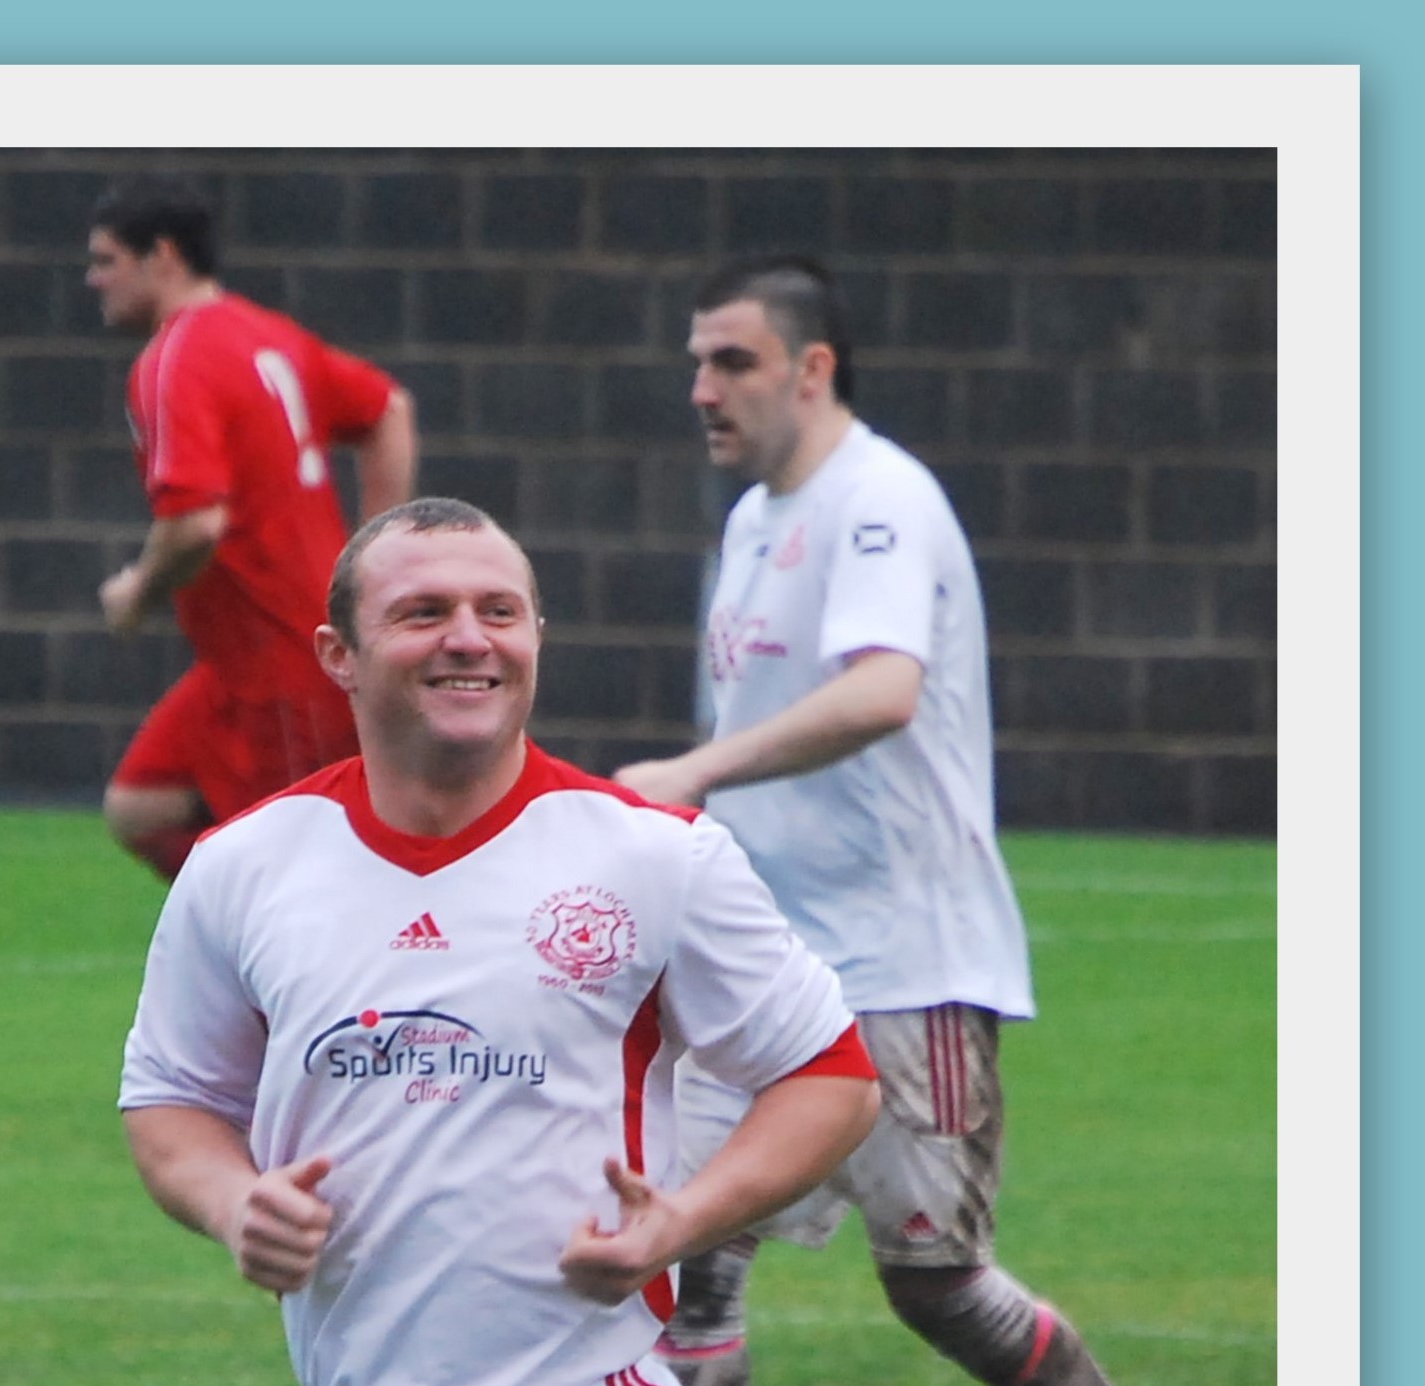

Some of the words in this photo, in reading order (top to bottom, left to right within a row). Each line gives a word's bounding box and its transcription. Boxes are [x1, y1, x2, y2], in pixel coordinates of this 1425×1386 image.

[595, 887, 631, 919] LOCH
[389, 937, 449, 951] adidas
[402, 1023, 471, 1046] Stadium
[328, 1046, 436, 1083] Sports
[450, 1045, 547, 1086] Injury
[404, 1080, 461, 1105] Clinic
